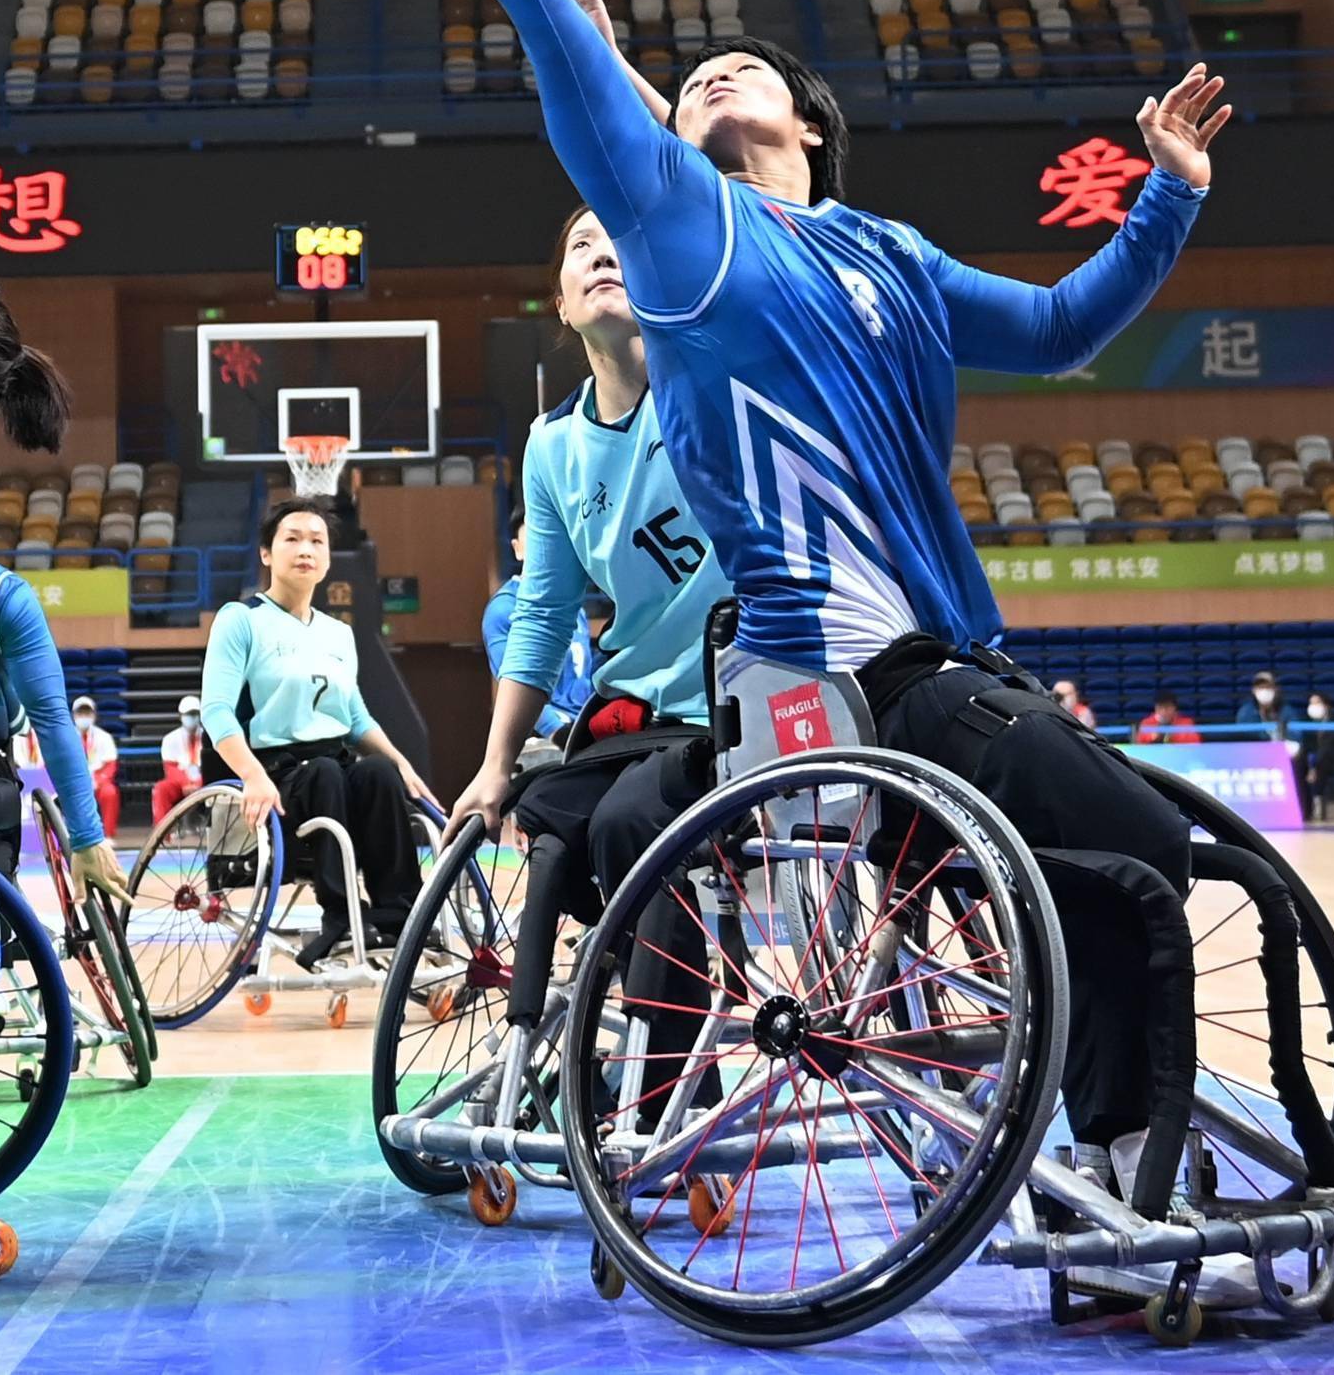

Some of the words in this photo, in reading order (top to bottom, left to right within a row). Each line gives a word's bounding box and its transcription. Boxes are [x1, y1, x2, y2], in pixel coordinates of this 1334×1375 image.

[1202, 318, 1260, 378] 起
[632, 506, 707, 586] 15
[987, 559, 1053, 581] 年古都
[310, 673, 329, 712] 7
[774, 696, 821, 722] FRAGILE
